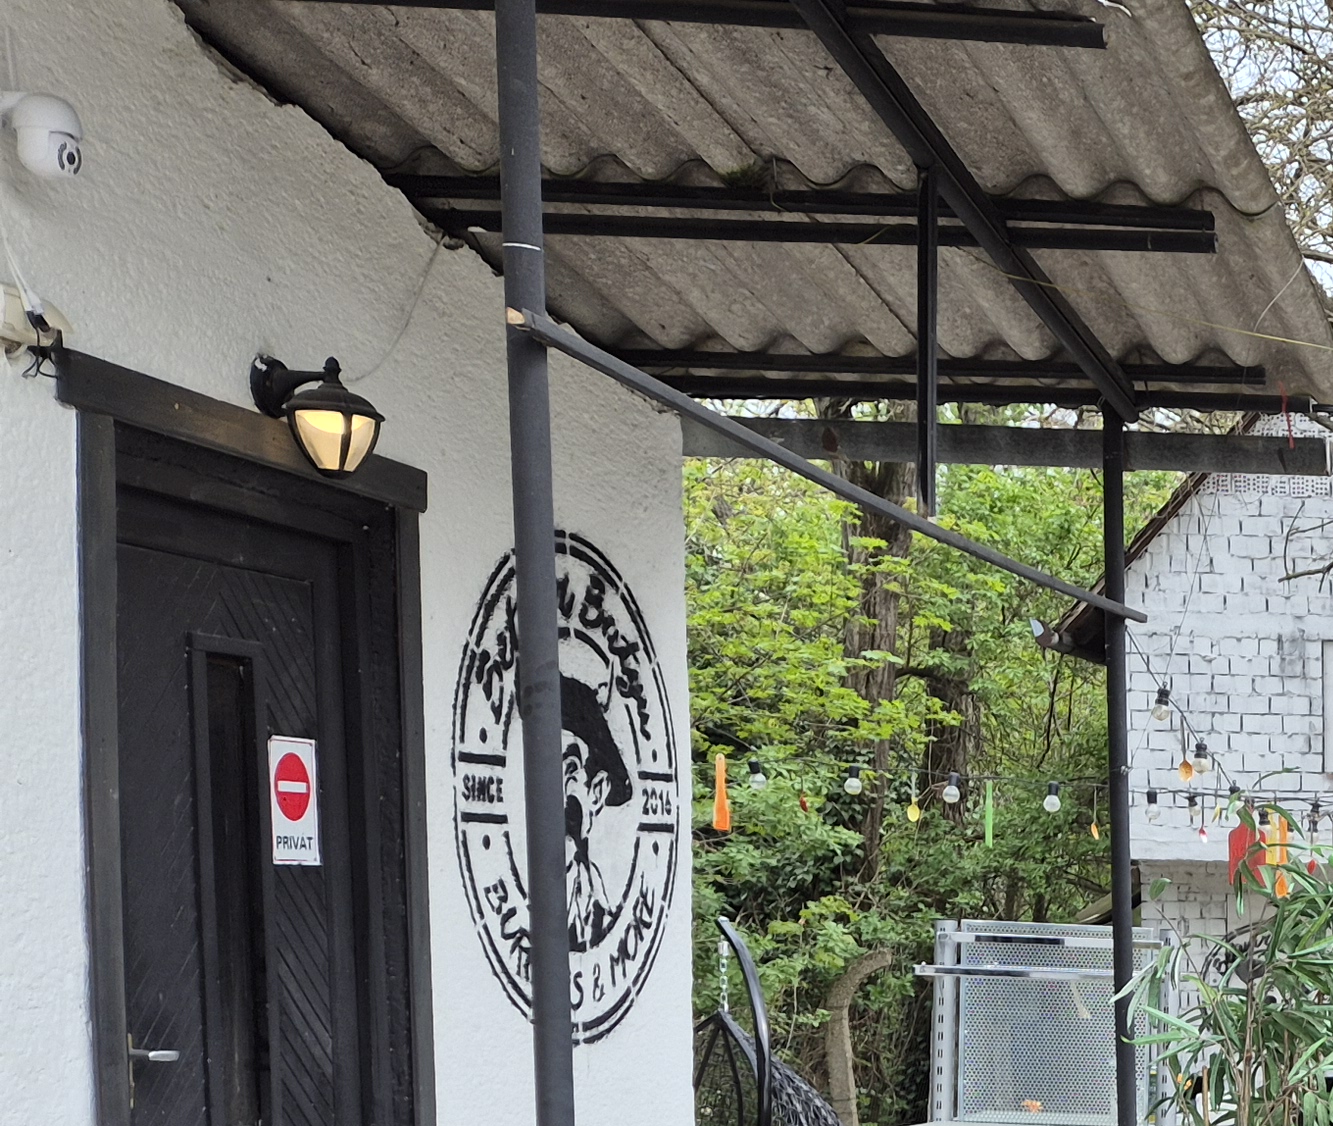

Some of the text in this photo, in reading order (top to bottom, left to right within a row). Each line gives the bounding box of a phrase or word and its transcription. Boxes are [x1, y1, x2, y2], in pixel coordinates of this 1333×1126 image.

[462, 773, 504, 804] SINCE
[641, 787, 672, 816] 2016
[276, 833, 313, 850] PRIVÁT
